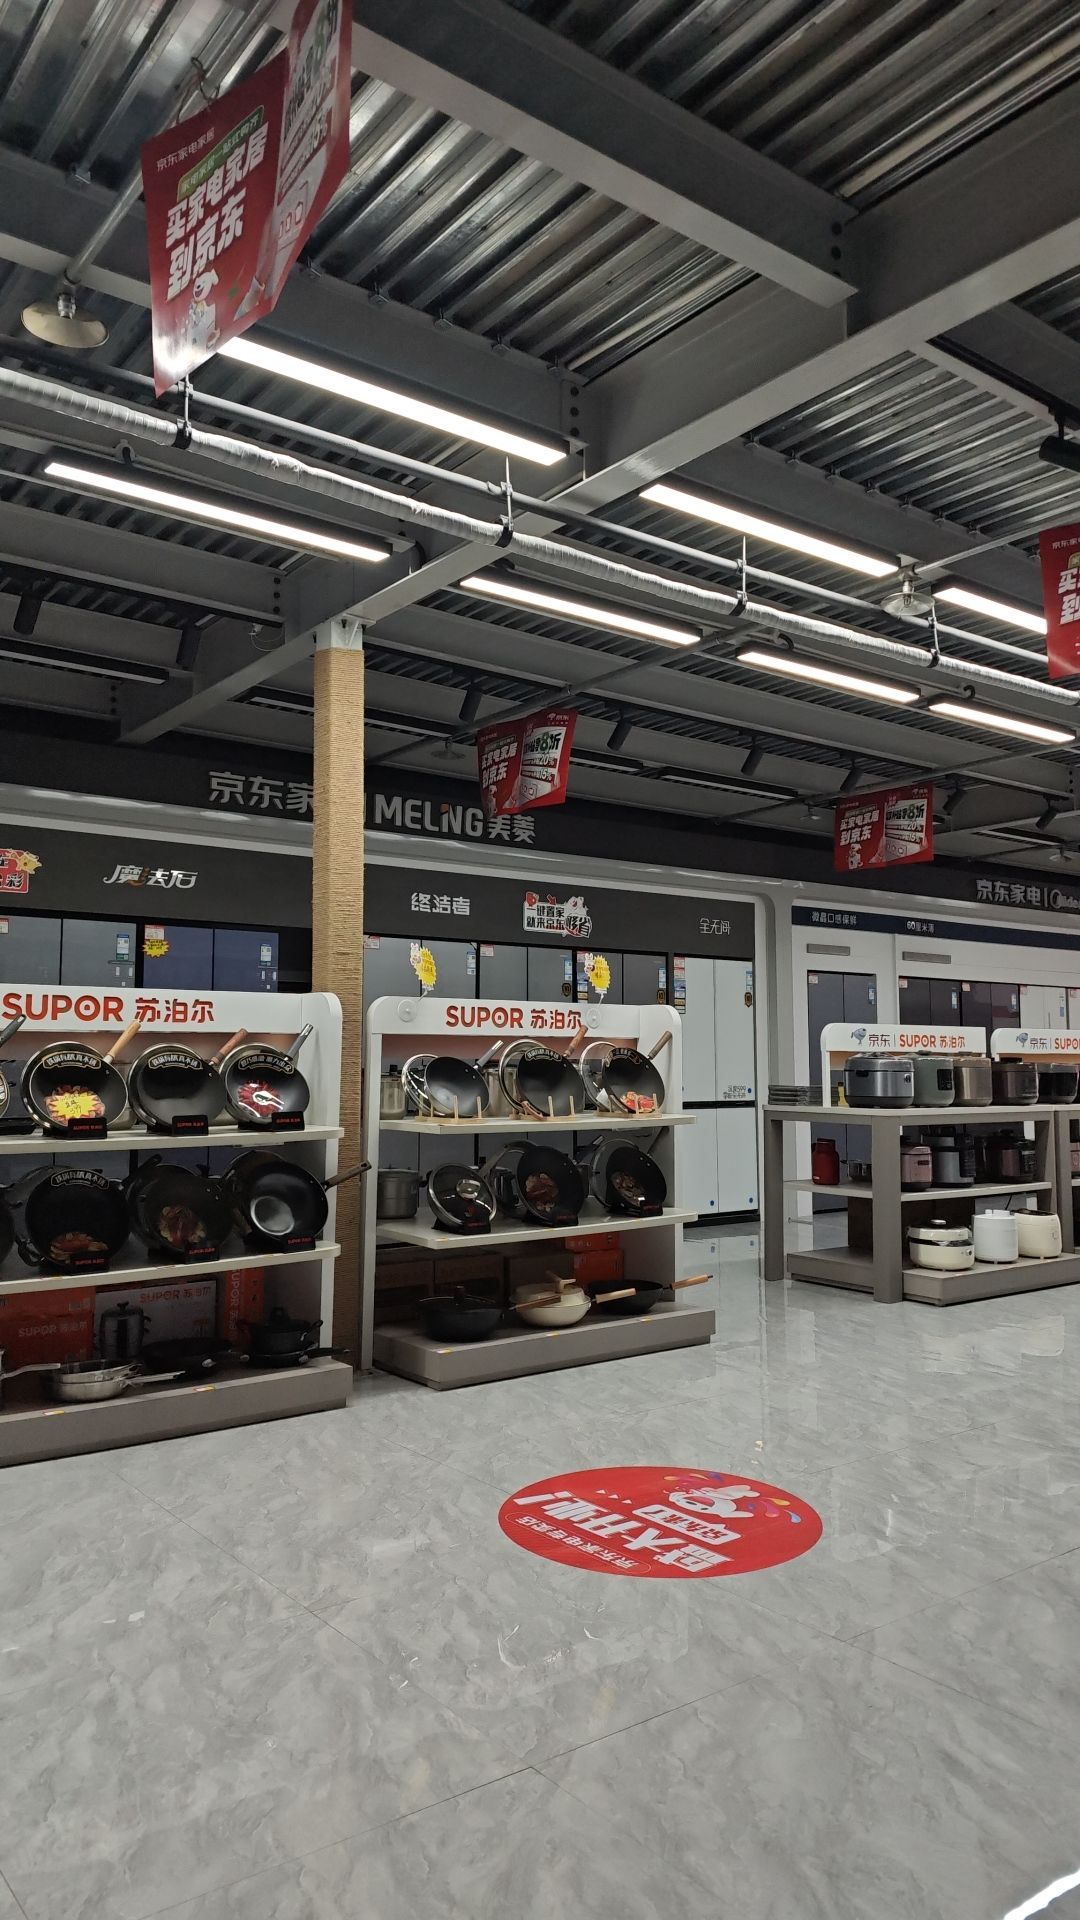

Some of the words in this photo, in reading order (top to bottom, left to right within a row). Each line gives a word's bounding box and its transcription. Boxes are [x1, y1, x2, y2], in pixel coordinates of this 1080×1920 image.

[156, 127, 216, 173] 京东家电家居
[166, 121, 269, 249] 买家电家居
[166, 187, 247, 302] 到京东
[1058, 567, 1080, 594] 买
[482, 742, 518, 769] 买家电家居
[482, 761, 509, 789] 到京东
[487, 813, 536, 844] 美菱
[840, 809, 880, 831] 买家电家居
[840, 825, 872, 846] 到京东
[411, 891, 471, 916] 终洁者
[976, 879, 1041, 906] 京东家电
[1, 992, 124, 1023] SUPOR
[134, 996, 215, 1025] 苏泊尔
[445, 1005, 524, 1029] SUPOR
[530, 1008, 582, 1030] 苏泊尔
[868, 1033, 891, 1048] 京东
[899, 1034, 937, 1049] SUPOR
[939, 1035, 966, 1049] 苏泊尔
[1029, 1037, 1048, 1050] 京东
[1054, 1038, 1080, 1050] SUPO
[140, 1289, 181, 1303] SUPOR
[230, 1269, 241, 1306] UPOR
[18, 1325, 57, 1337] SUPOR
[643, 1509, 731, 1542] 京东来了
[516, 1515, 640, 1570] 京东家电专卖店
